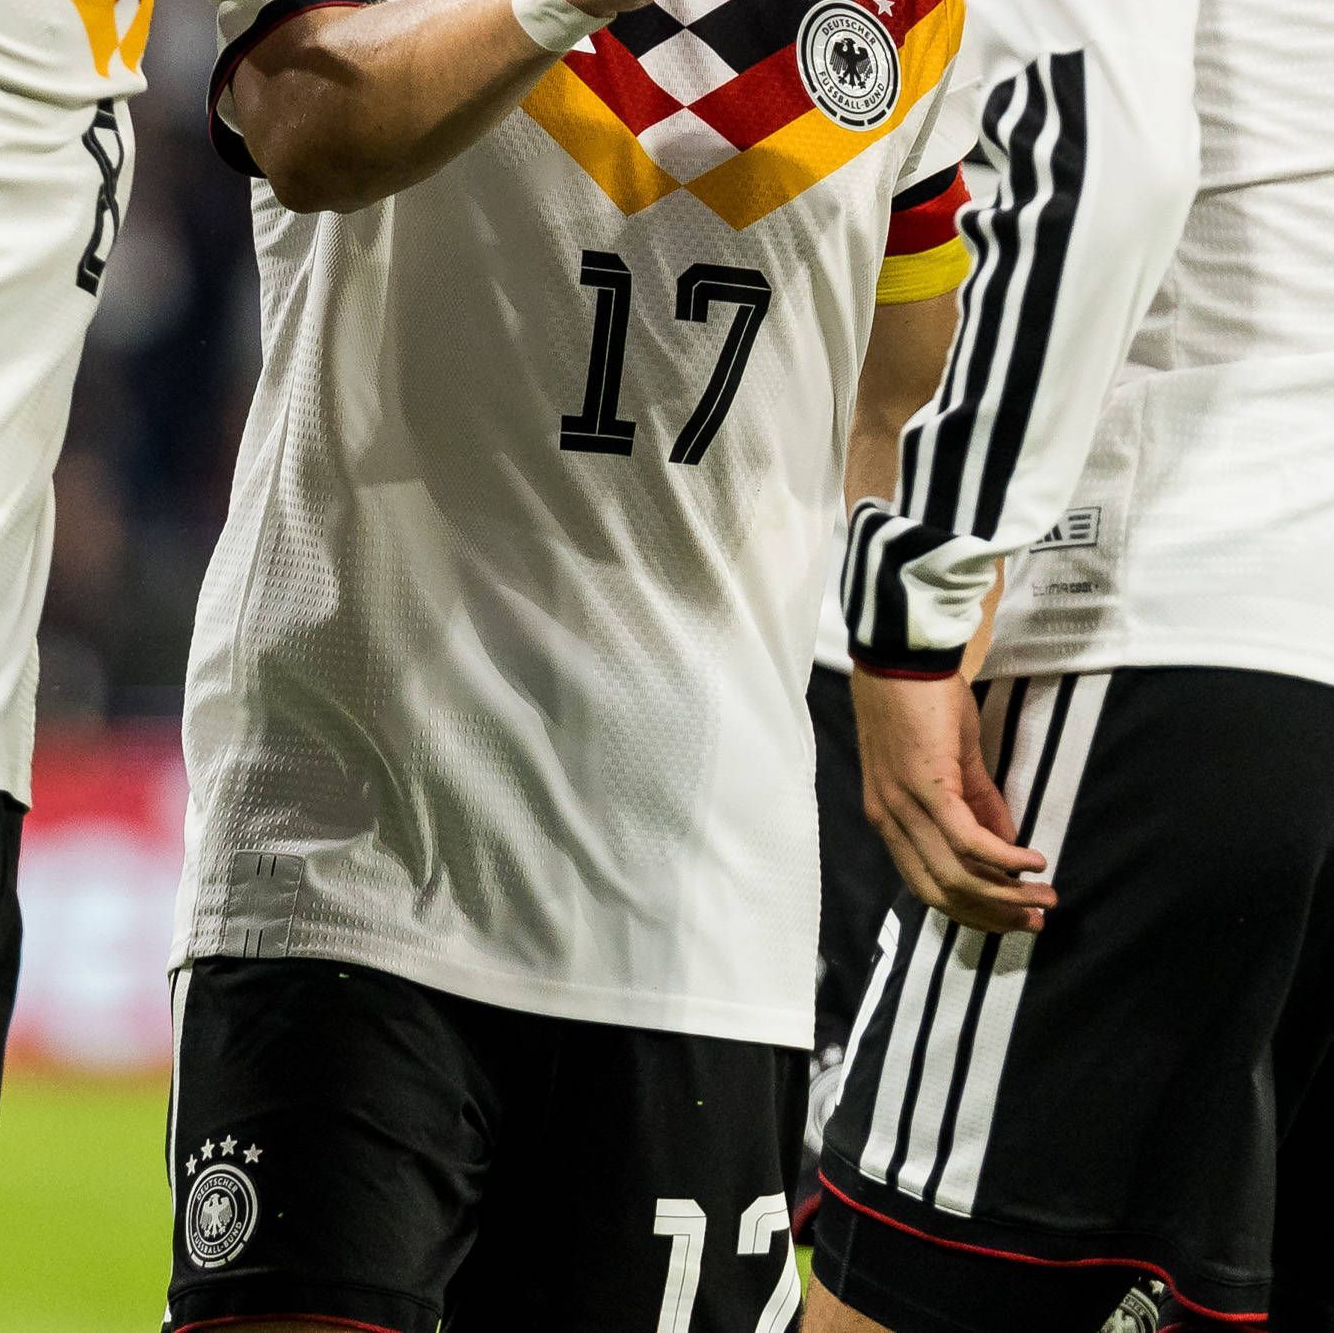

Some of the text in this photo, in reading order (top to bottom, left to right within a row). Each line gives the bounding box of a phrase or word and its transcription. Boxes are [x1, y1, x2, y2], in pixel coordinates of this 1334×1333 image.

[821, 18, 877, 46] DEUTSCHER
[818, 70, 885, 110] FUSSBALL-BUND
[559, 249, 773, 466] 17
[196, 1177, 239, 1201] DEUTSCHER
